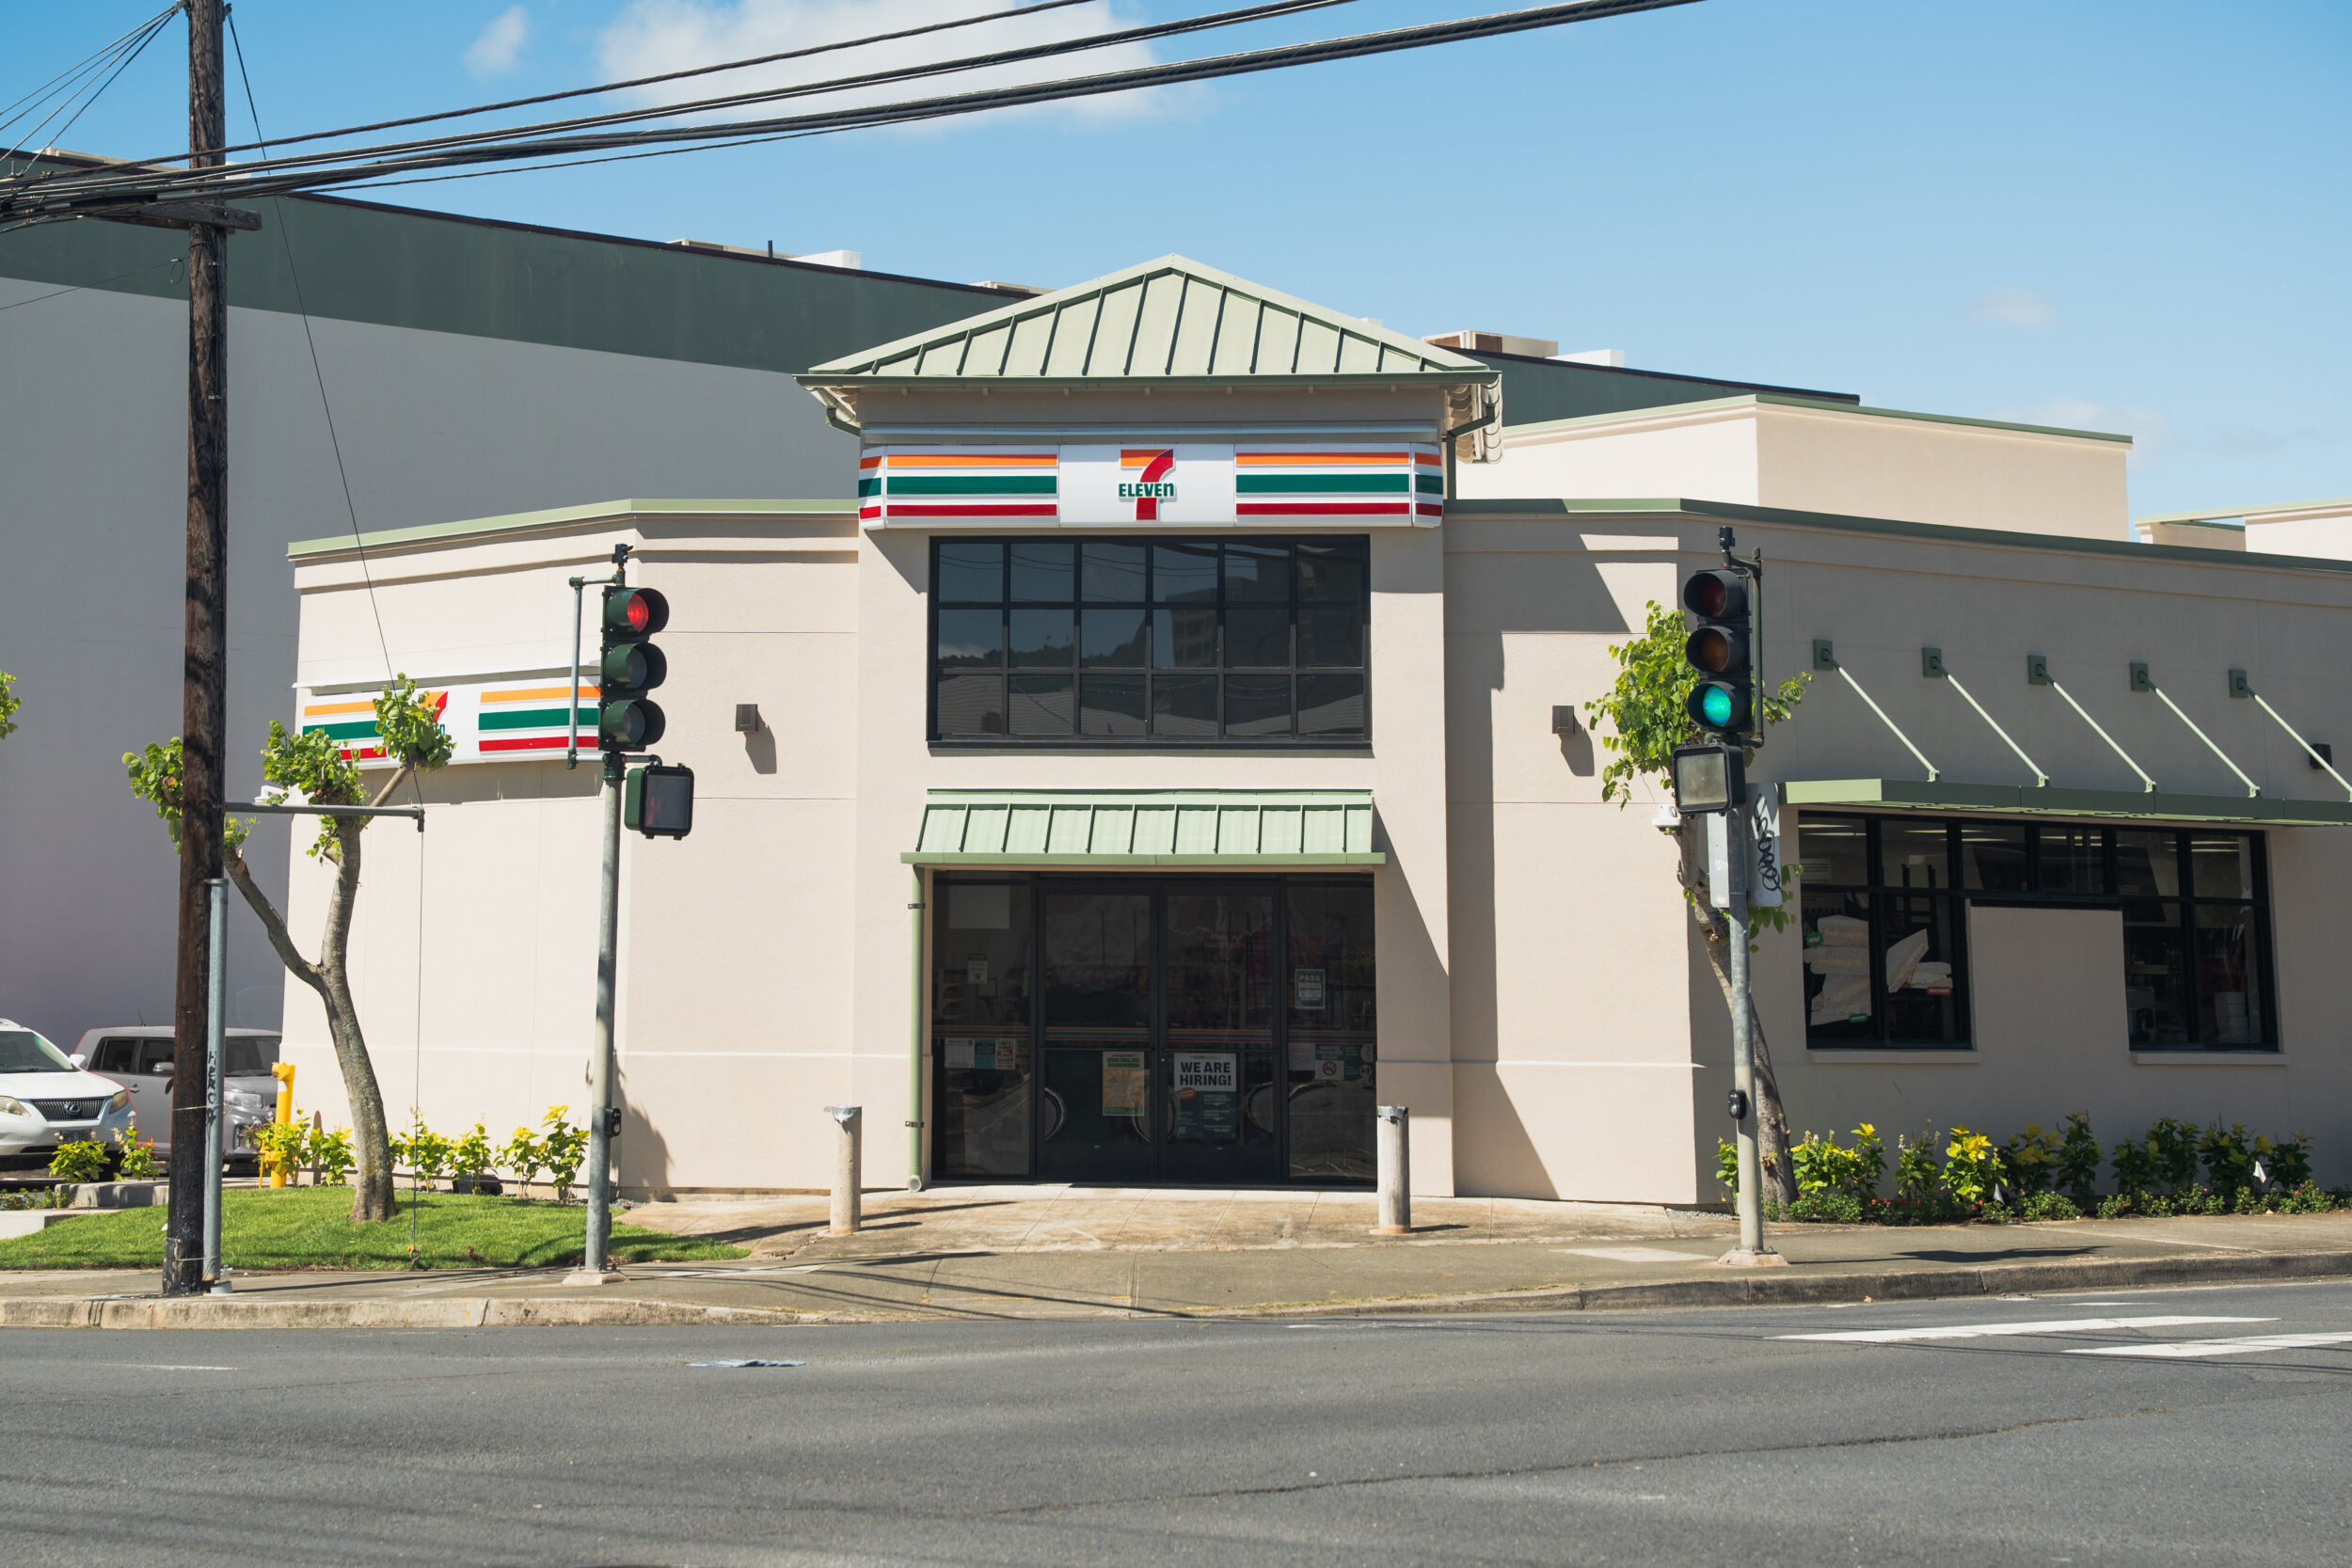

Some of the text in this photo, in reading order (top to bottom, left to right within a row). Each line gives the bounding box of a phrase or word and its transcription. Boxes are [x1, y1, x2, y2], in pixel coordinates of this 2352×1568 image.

[1120, 449, 1174, 520] 7
[1181, 1062, 1231, 1073] WE ARE
[1180, 1074, 1232, 1085] HIRING!
